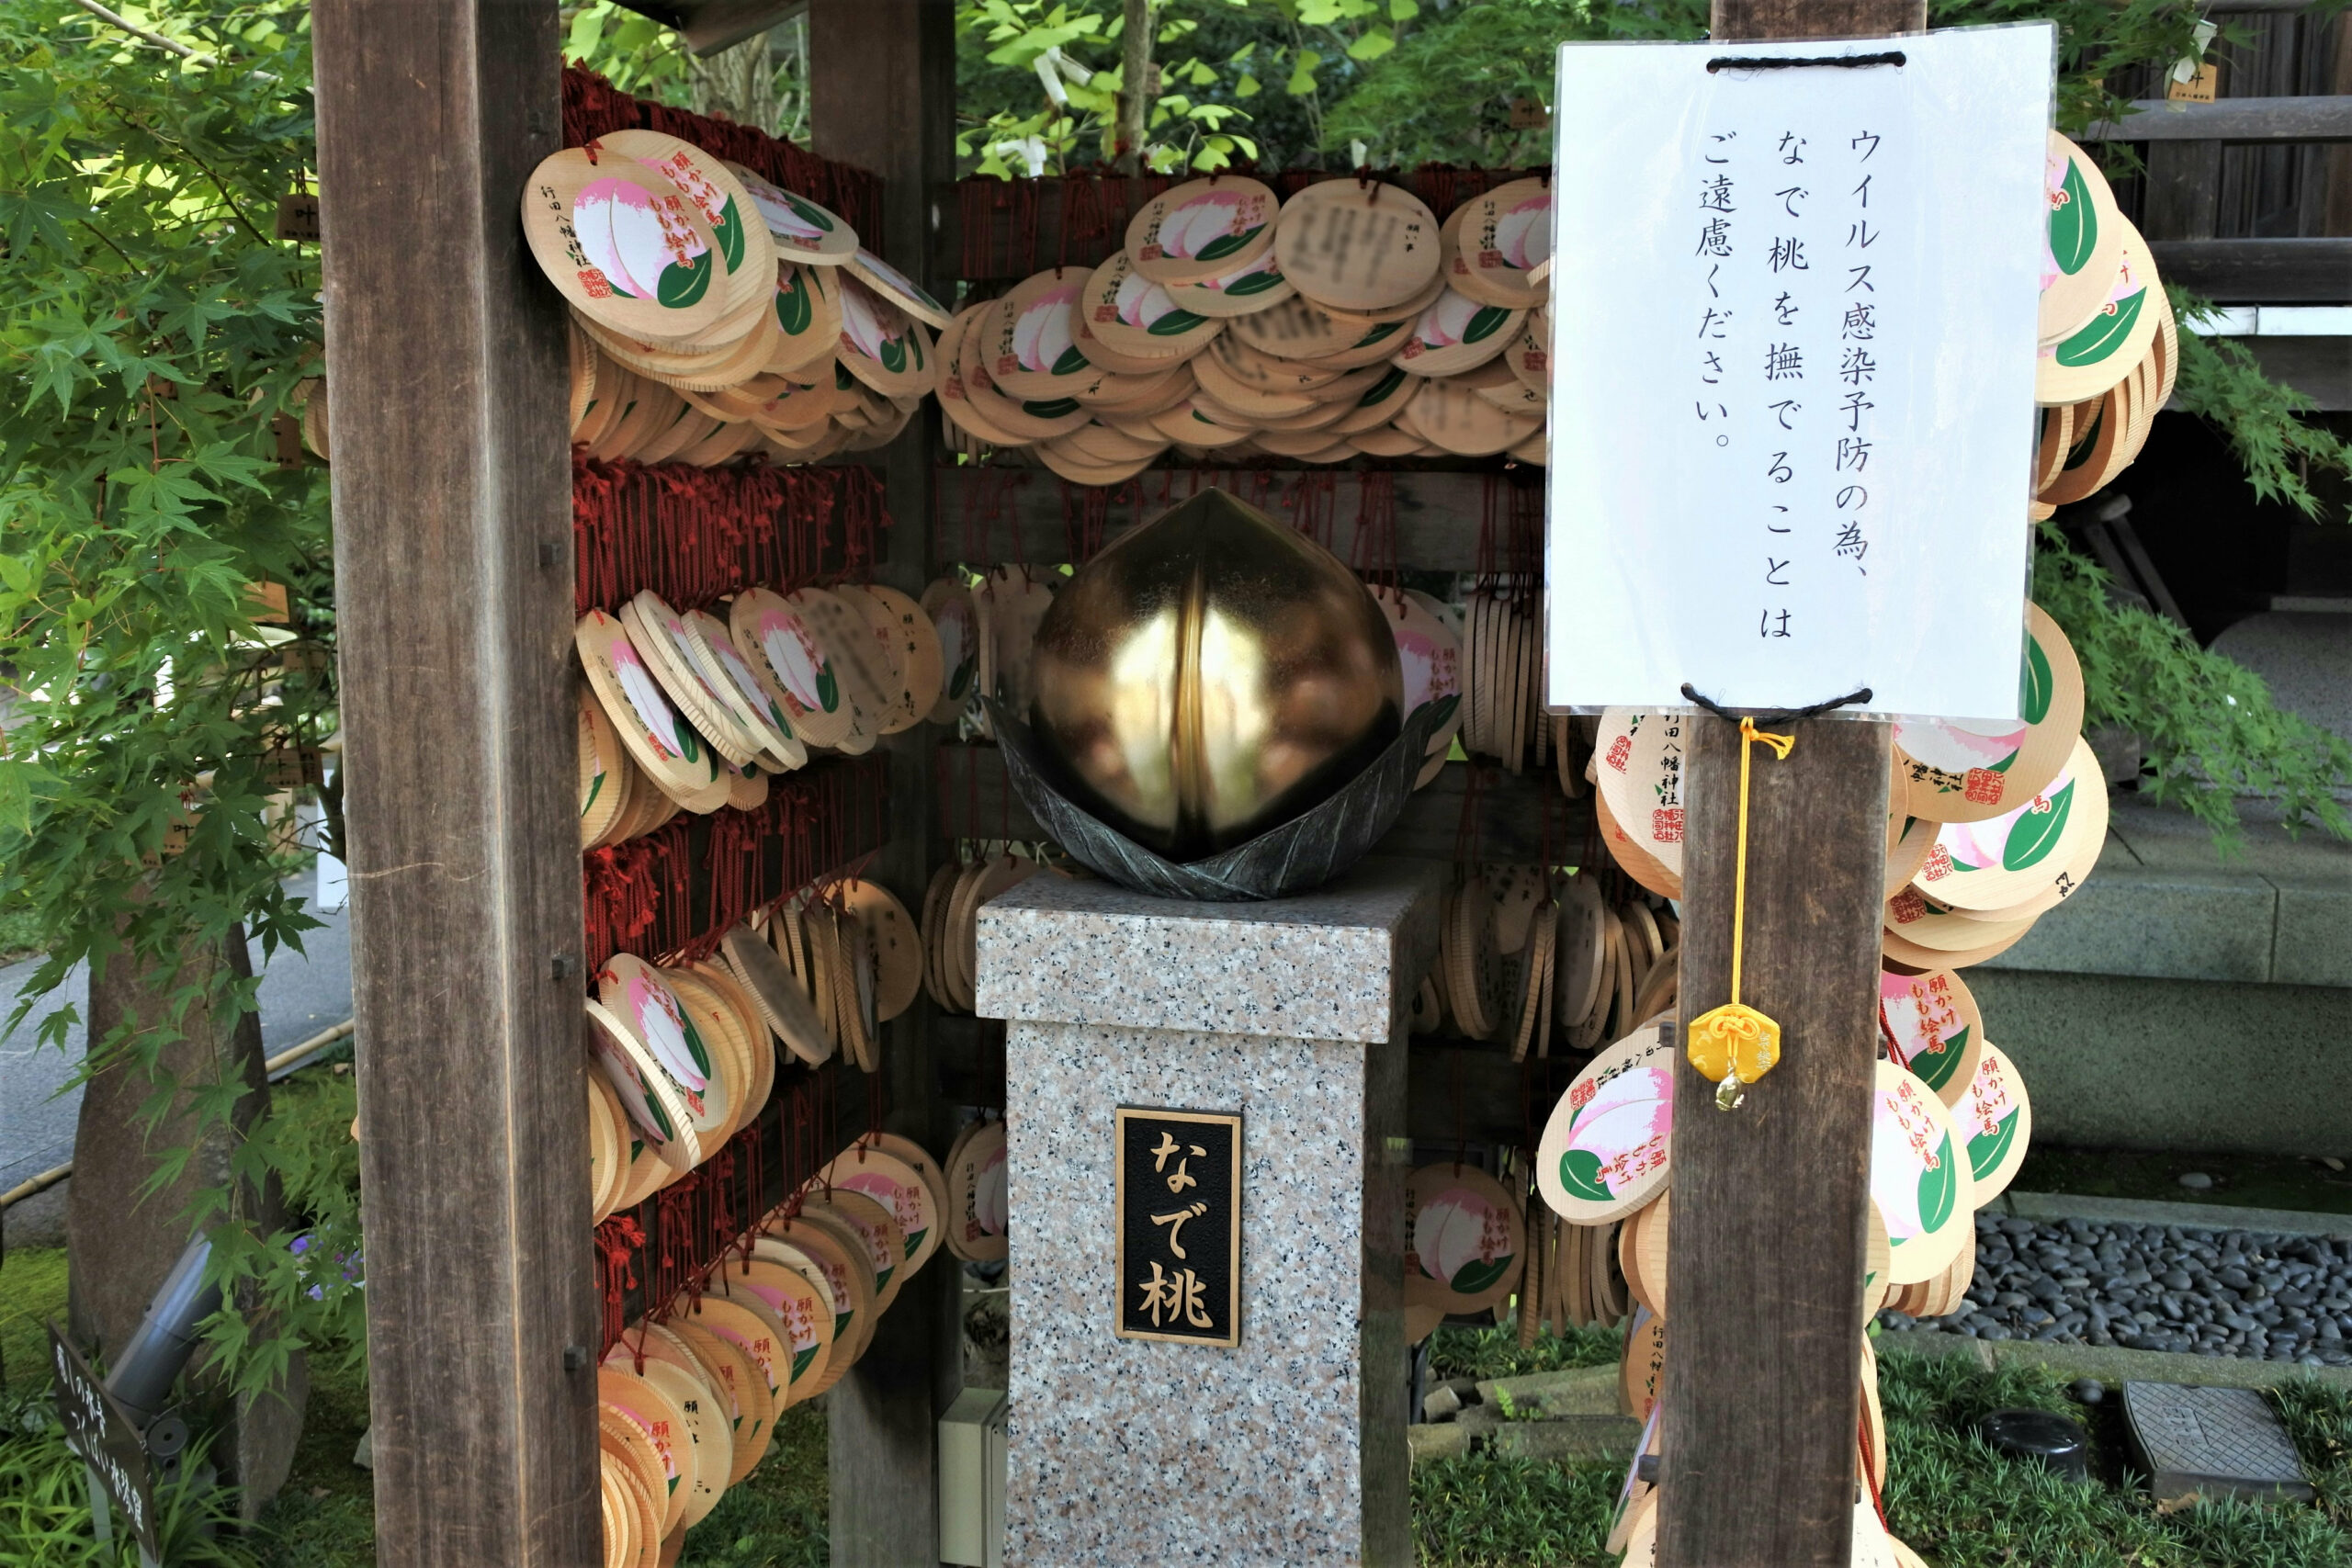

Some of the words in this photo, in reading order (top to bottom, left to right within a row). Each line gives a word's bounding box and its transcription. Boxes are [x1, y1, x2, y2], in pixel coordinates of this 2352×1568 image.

[661, 165, 725, 228] もも絵馬
[672, 151, 718, 197] 願かけ
[540, 186, 591, 267] 行田八幡神社
[649, 196, 695, 268] もも絵馬
[664, 195, 699, 248] 願かけ
[1694, 131, 1738, 448] ご遠慮ください。
[1831, 130, 1882, 578] ウイルス感染予防の為、
[1760, 130, 1809, 638] なで桃を撫でることは
[1910, 982, 1946, 1055] もも絵馬
[1928, 974, 1956, 1027] 願かけ
[1896, 1079, 1935, 1133] 願かけ
[1981, 1056, 2007, 1107] 願かけ
[1595, 1134, 1663, 1183] もも絵馬
[1885, 1096, 1940, 1172] もも絵馬
[1618, 1148, 1668, 1185] 願かけ
[906, 1187, 922, 1224] 願かけ
[1138, 1131, 1214, 1328] なで桃
[874, 1224, 889, 1265] 願かけ
[797, 1297, 814, 1341] 願かけ
